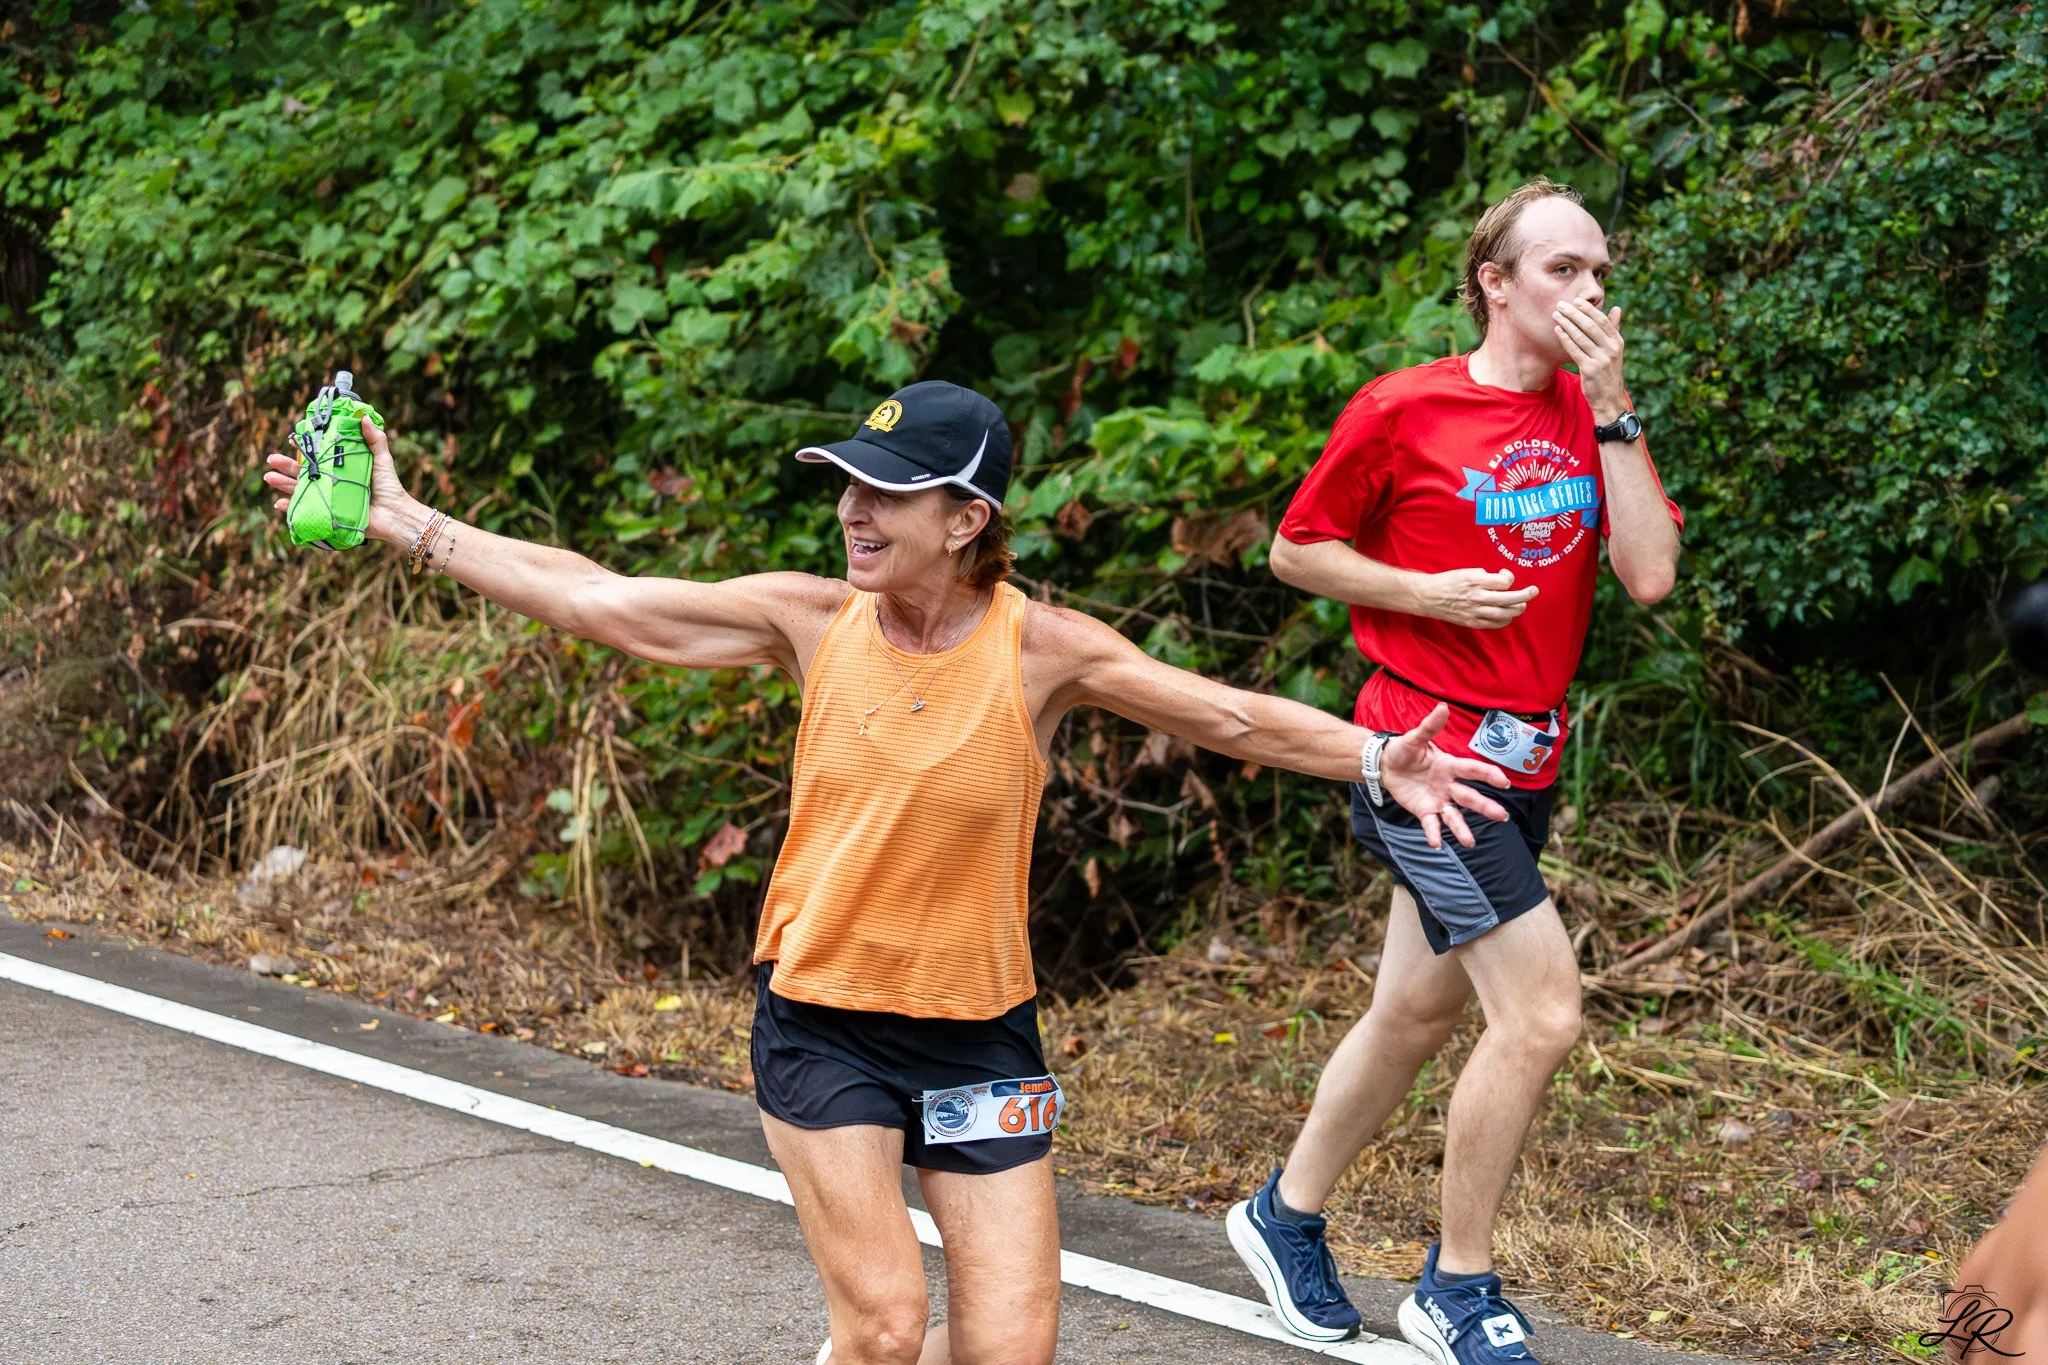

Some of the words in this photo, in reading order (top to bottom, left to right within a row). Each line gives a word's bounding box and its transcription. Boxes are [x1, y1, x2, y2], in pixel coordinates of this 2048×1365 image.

[1488, 453, 1503, 470] EJ
[1504, 438, 1580, 467] GOLDSMITH
[1485, 497, 1516, 520] ROAD
[1549, 481, 1592, 510] SERIES
[1517, 557, 1534, 568] 10K
[1538, 553, 1560, 567] 10MI
[1523, 746, 1547, 771] 3
[998, 1092, 1058, 1134] 616
